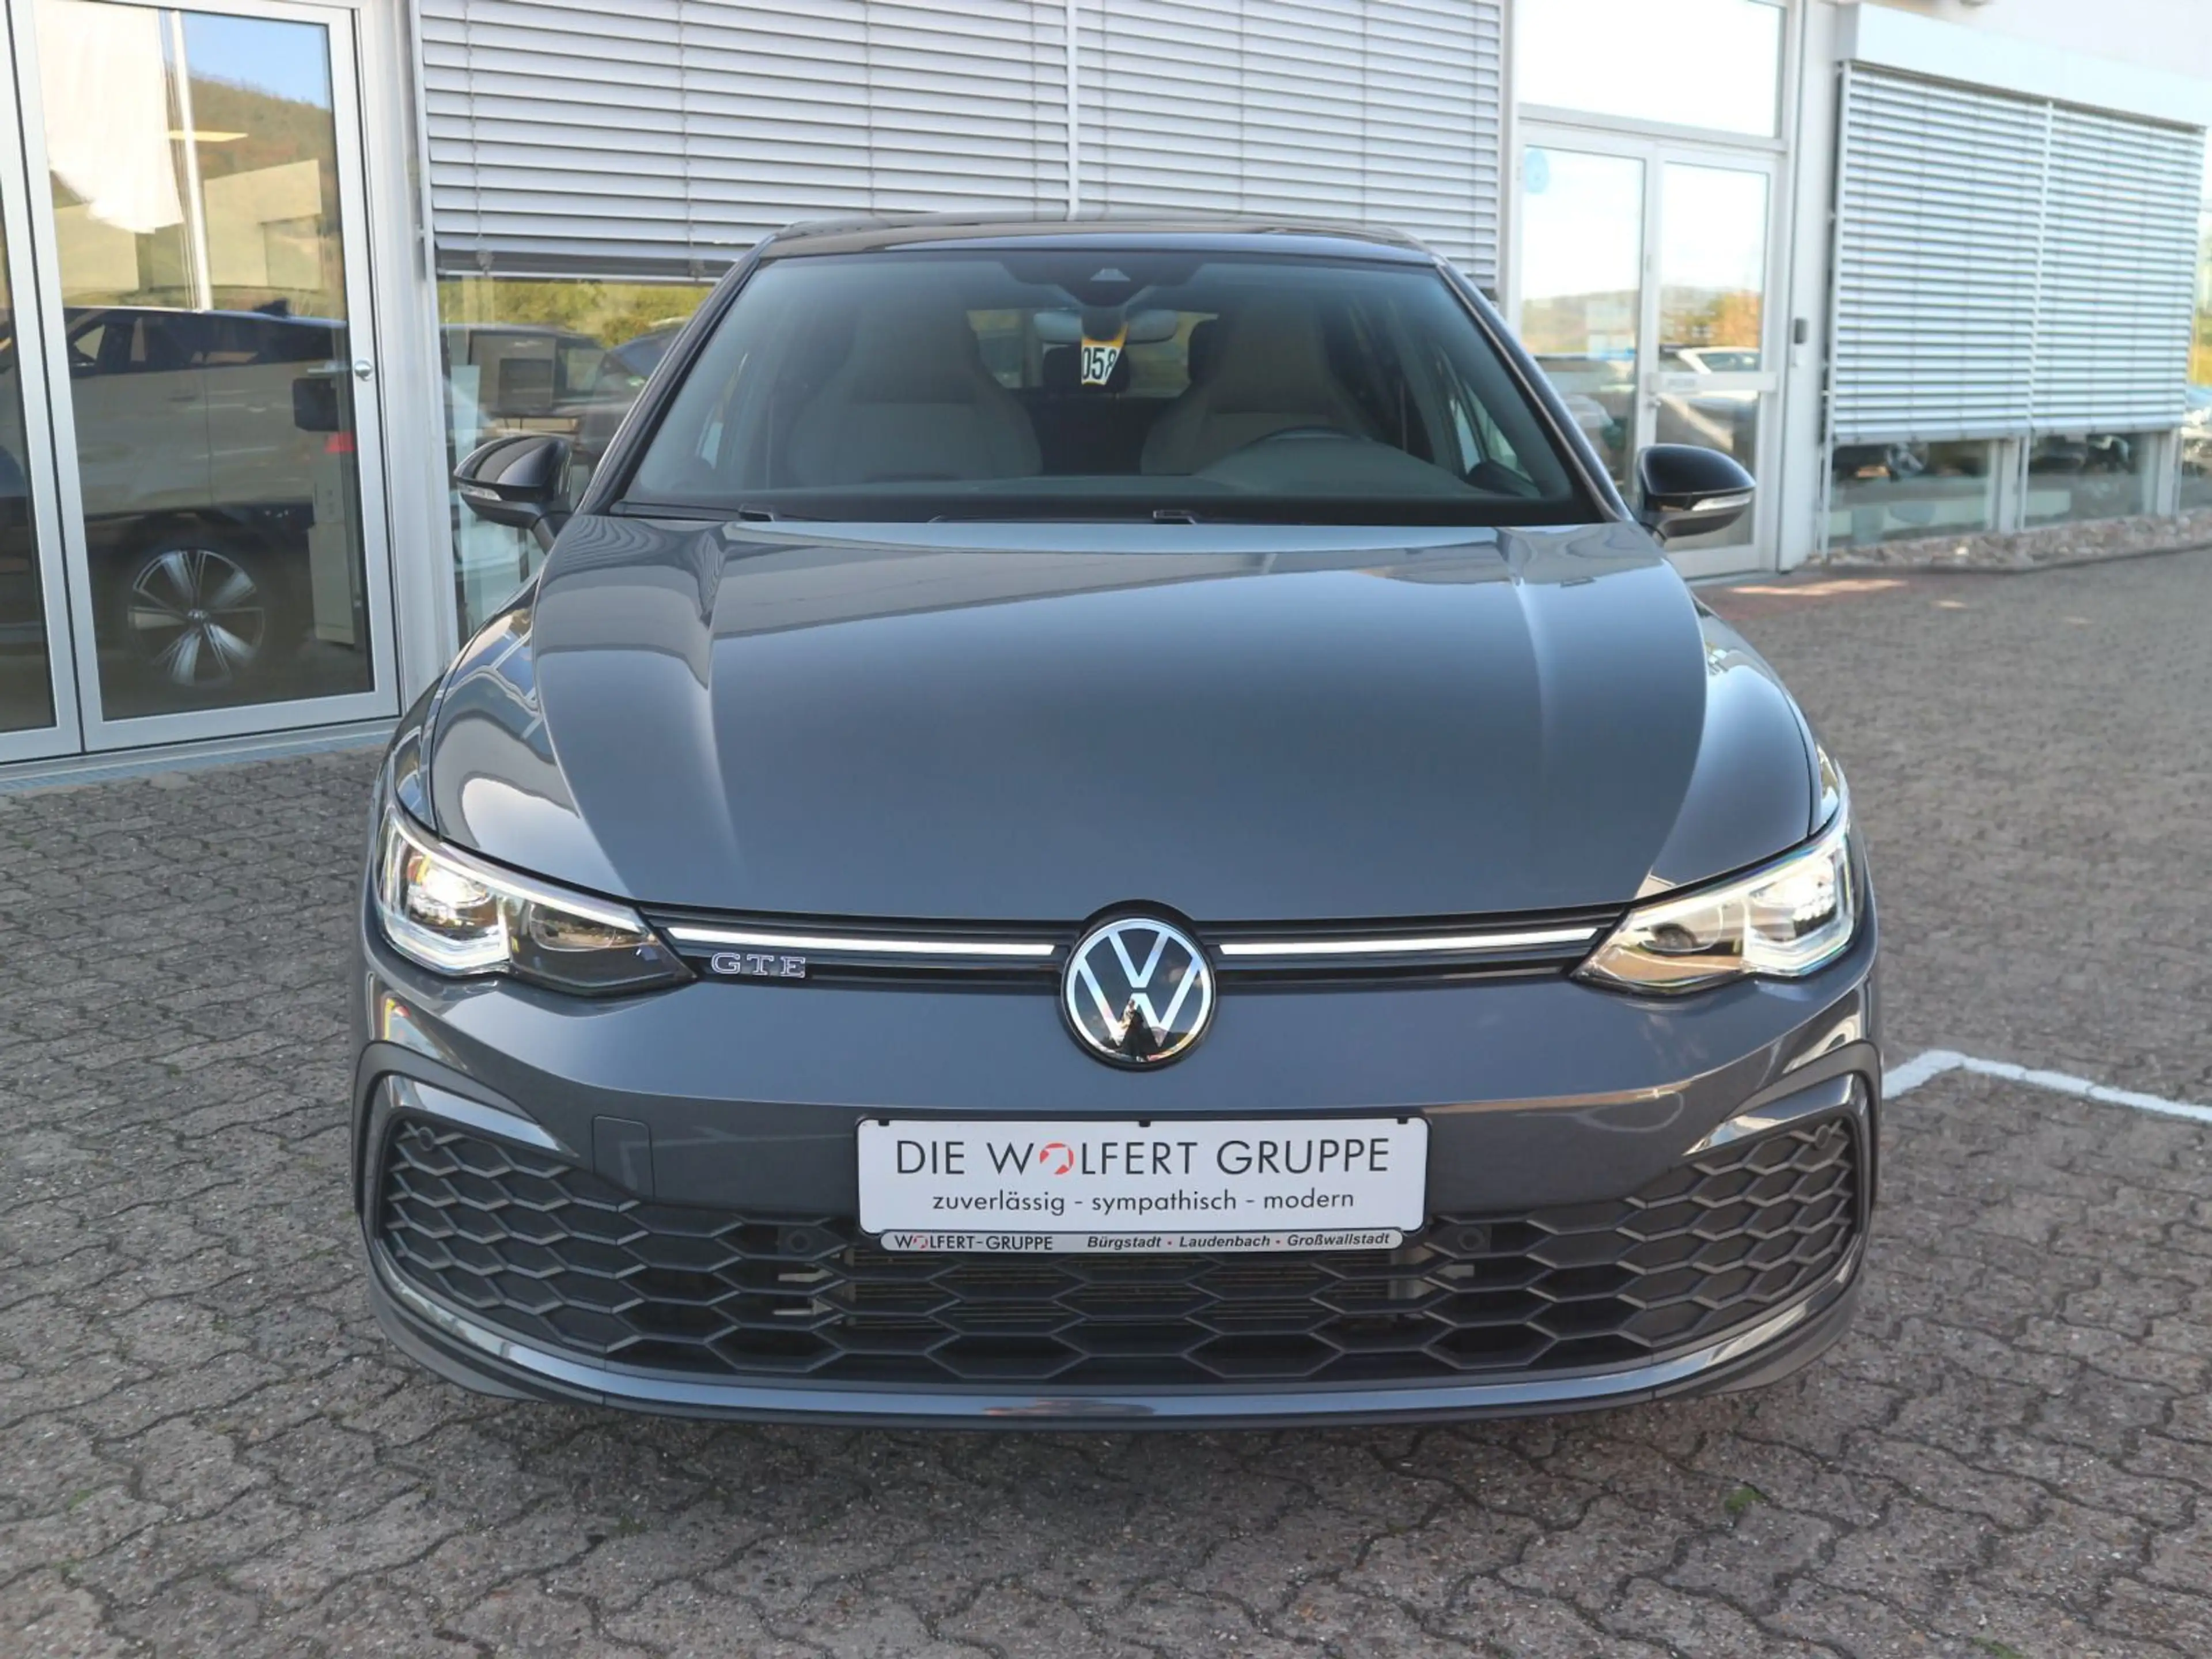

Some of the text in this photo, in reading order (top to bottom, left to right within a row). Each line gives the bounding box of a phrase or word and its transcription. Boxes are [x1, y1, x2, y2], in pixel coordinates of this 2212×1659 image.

[711, 952, 806, 978] GTE
[896, 1139, 965, 1175] DIE
[1216, 1138, 1389, 1175] GRUPPE
[932, 1189, 1065, 1216] zuverlässig
[1092, 1188, 1237, 1215] sympathisch
[1264, 1187, 1354, 1209] modern
[1087, 1233, 1390, 1249] Bürgstadt Laudenbach Großwallstadt
